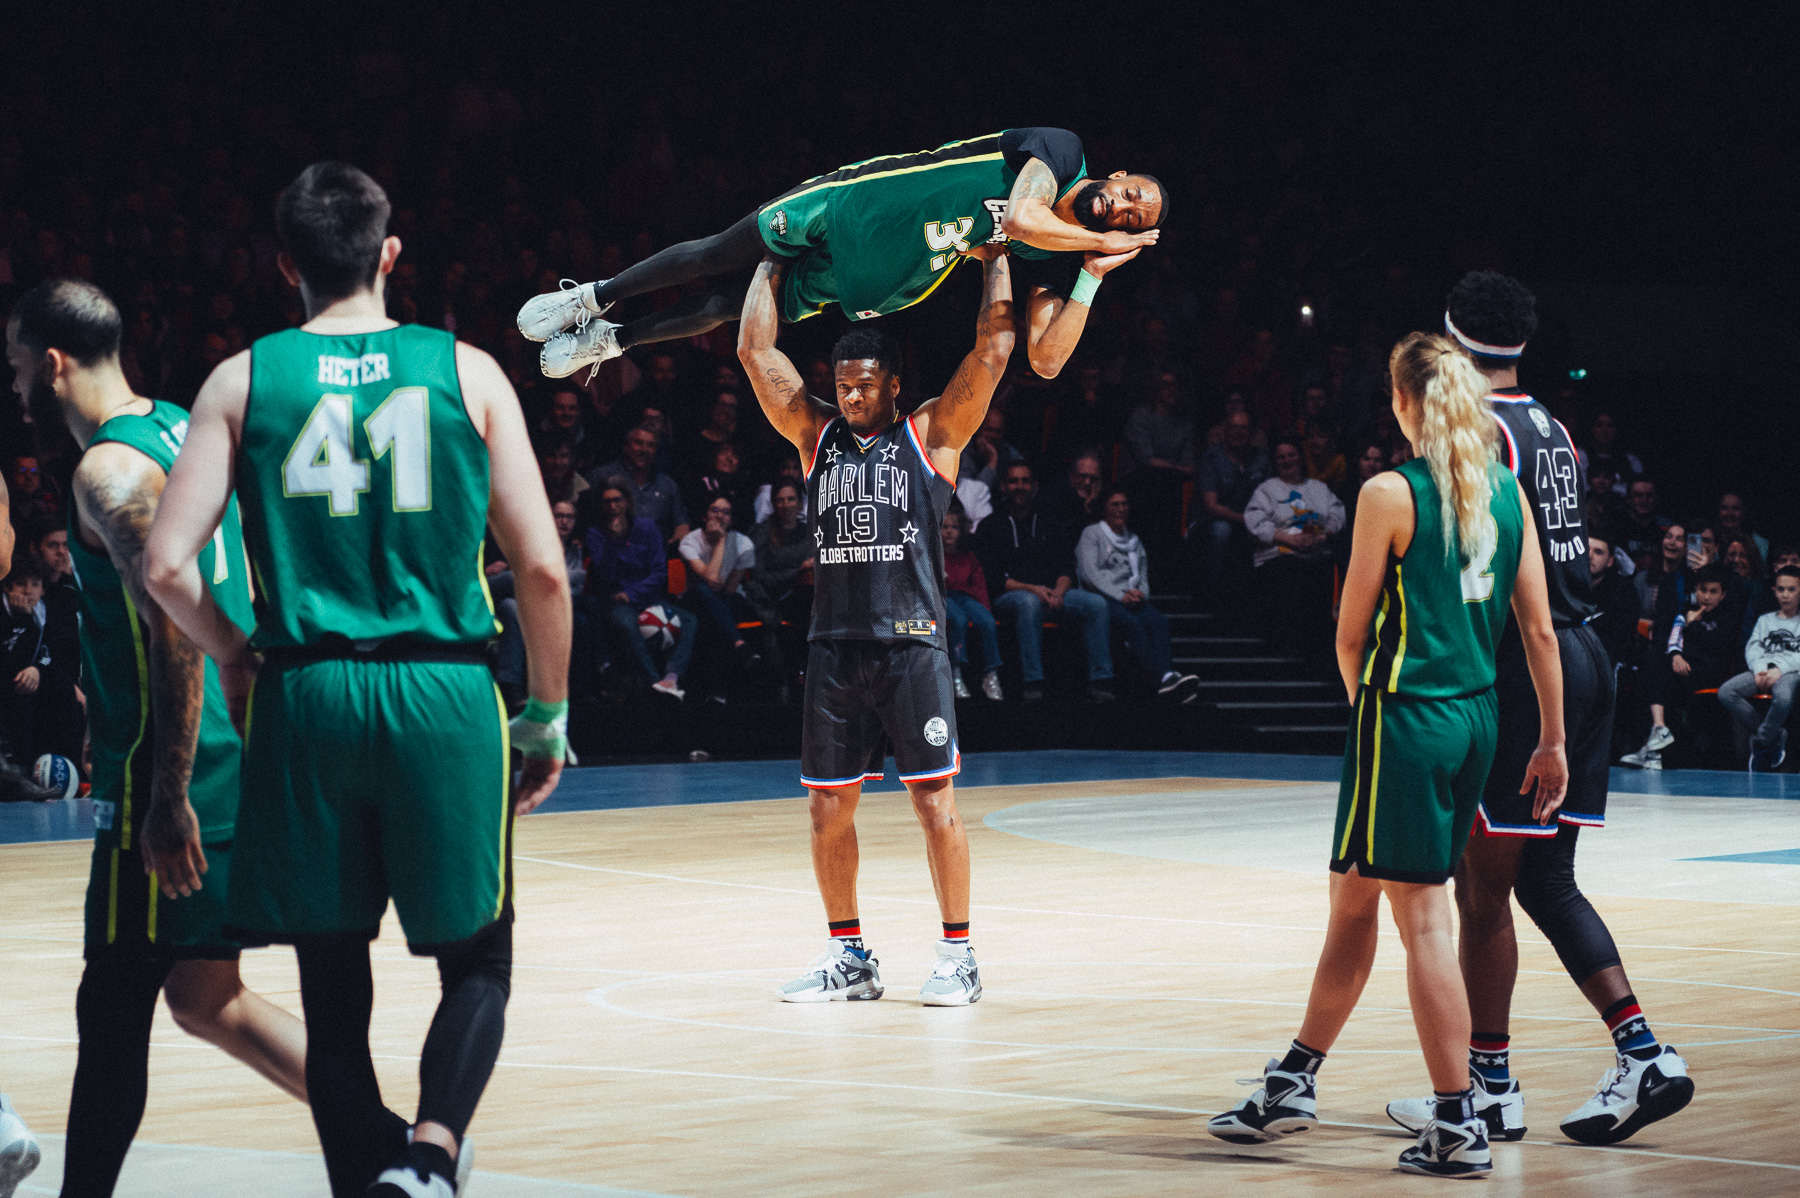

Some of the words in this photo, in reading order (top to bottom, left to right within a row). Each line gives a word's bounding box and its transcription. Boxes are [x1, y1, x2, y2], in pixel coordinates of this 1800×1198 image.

[318, 352, 391, 387] HETER
[281, 386, 433, 518] 41
[818, 462, 909, 516] HARLEM
[1535, 447, 1582, 531] 43
[836, 504, 879, 545] 19
[819, 544, 905, 564] GLOBETROTTERS
[1550, 535, 1586, 562] TURBO
